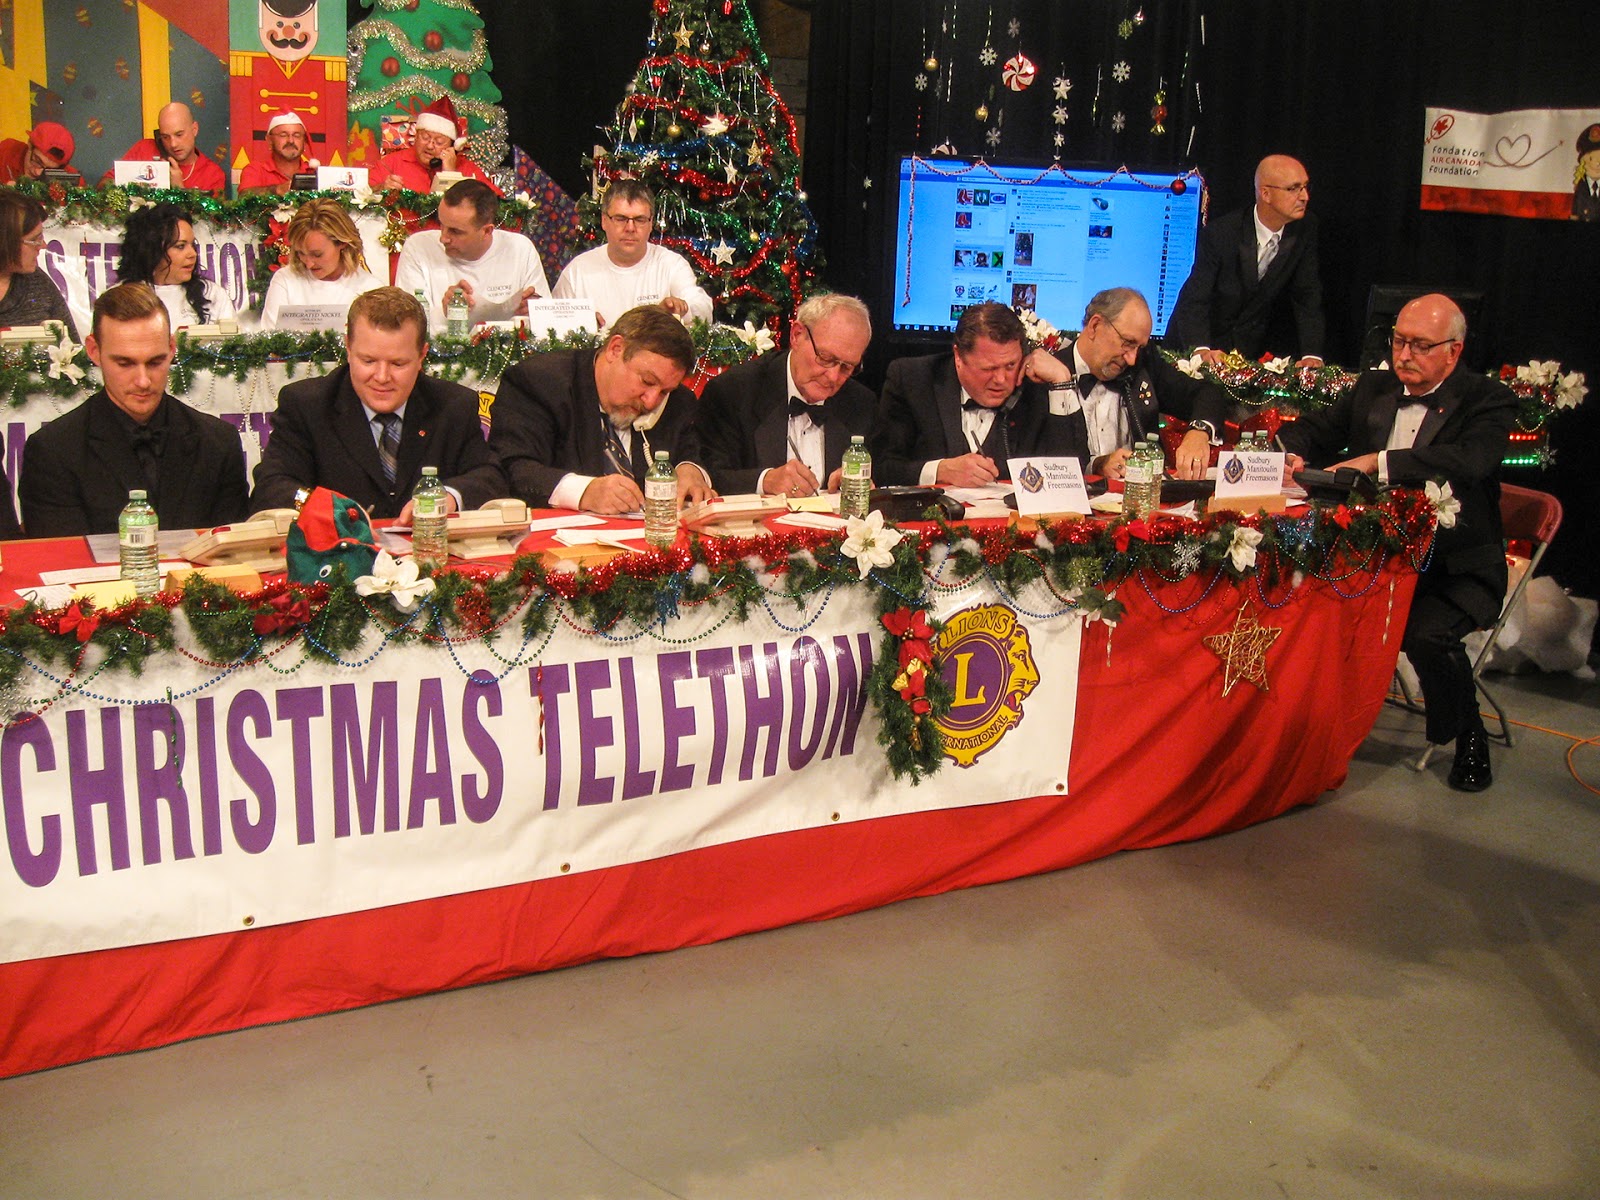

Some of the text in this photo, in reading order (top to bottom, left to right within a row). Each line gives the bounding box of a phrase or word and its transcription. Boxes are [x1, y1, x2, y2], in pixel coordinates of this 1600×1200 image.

[1431, 156, 1481, 167] AIR CANADA
[1247, 456, 1271, 465] Sudbury
[1044, 463, 1068, 472] Sudbury
[1246, 465, 1278, 473] Manitoulin
[1045, 472, 1078, 480] Manitoulin
[1047, 481, 1082, 489] Freemasons
[945, 611, 1010, 644] LIONS
[952, 652, 986, 707] L
[941, 714, 1009, 749] RNATIONAL
[1, 632, 870, 888] CHRISTMAS TELETHON
